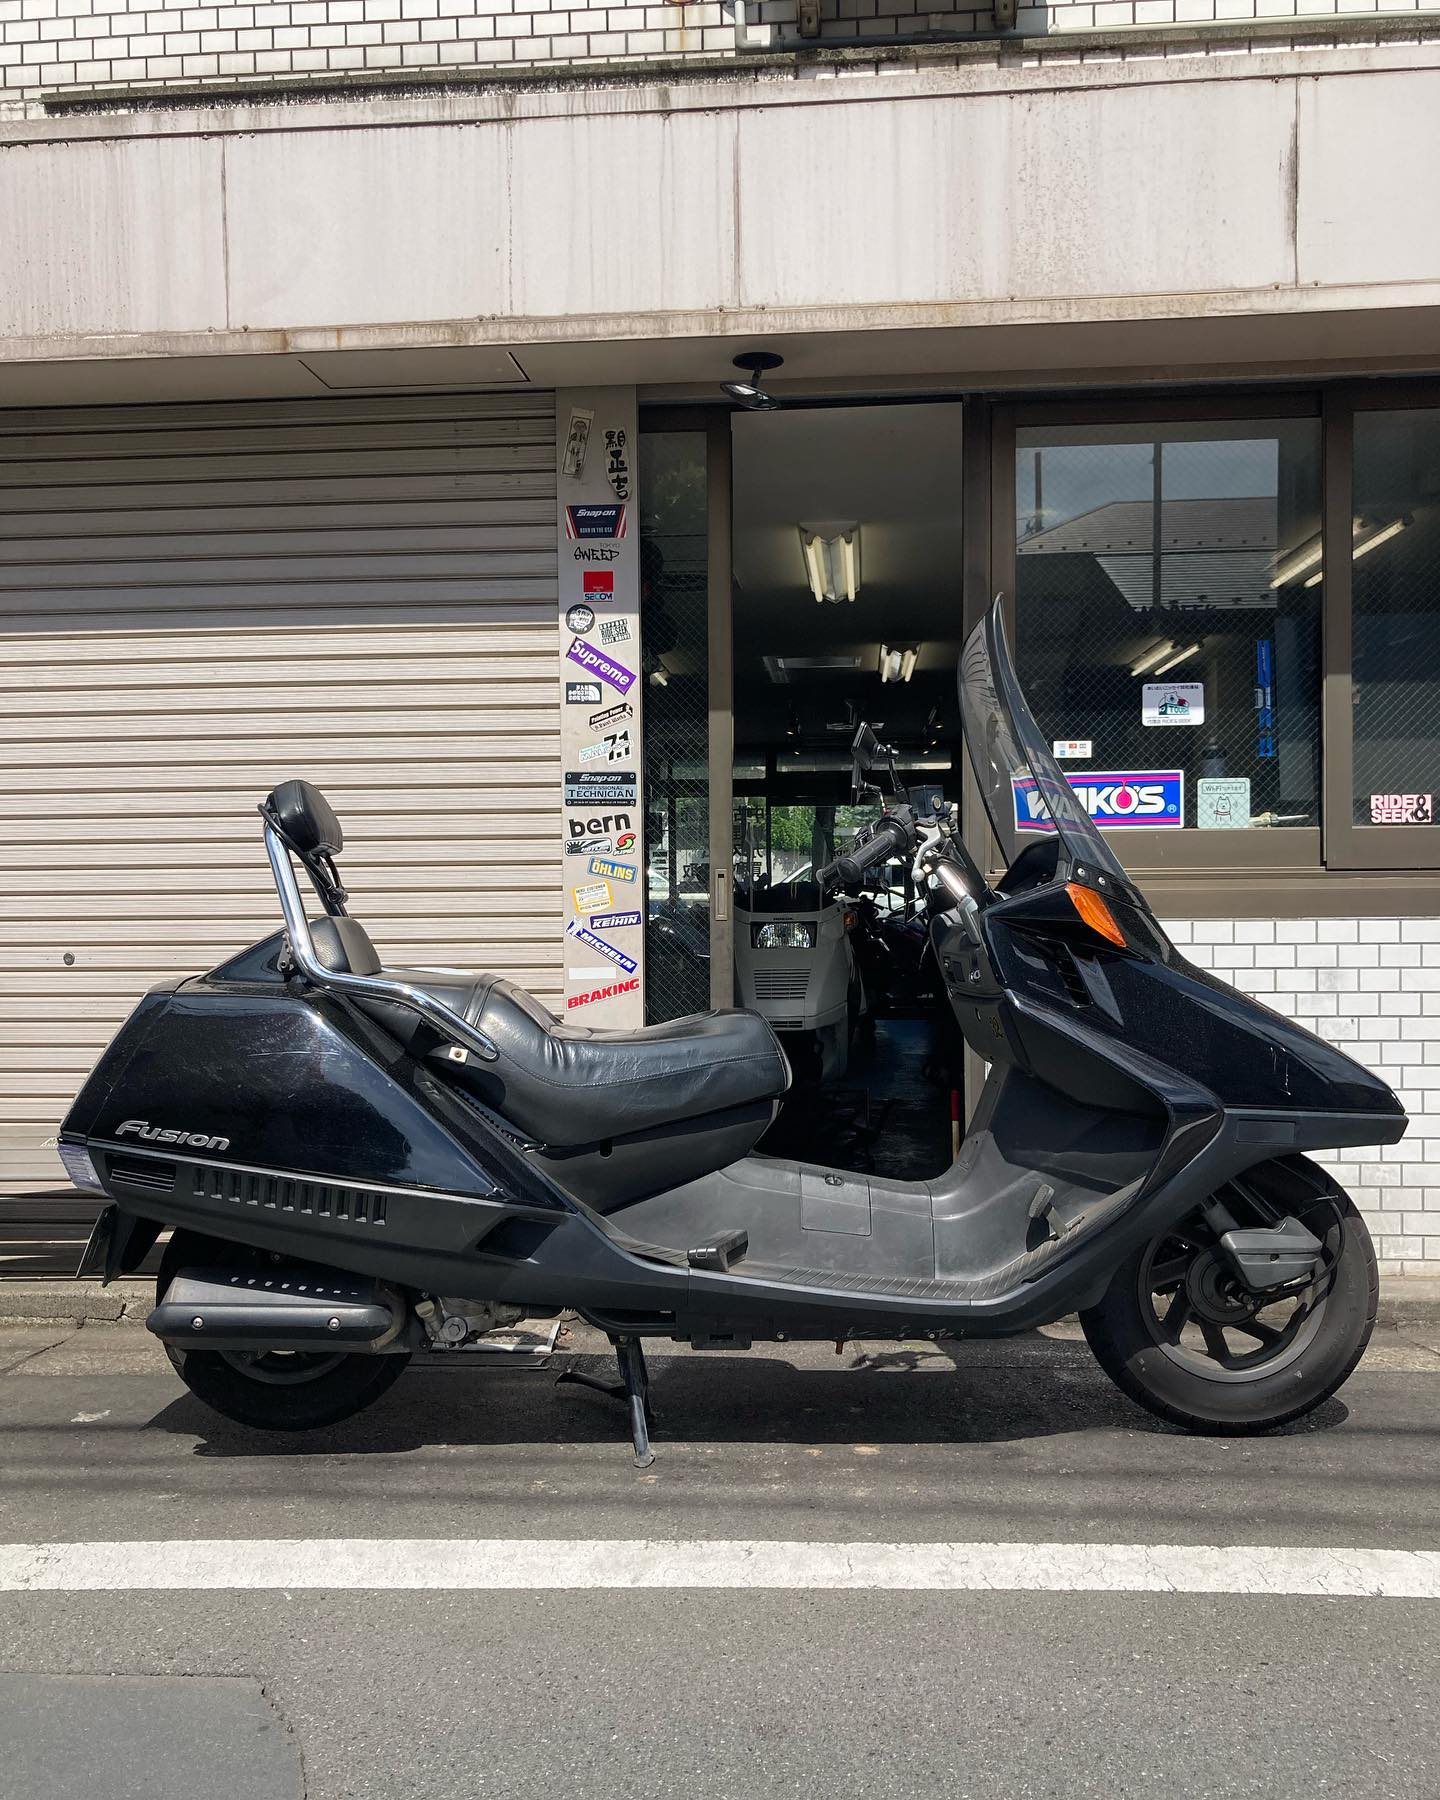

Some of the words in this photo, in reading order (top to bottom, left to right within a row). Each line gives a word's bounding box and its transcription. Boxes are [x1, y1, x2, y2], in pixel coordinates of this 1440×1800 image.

[576, 509, 616, 517] Snap-on
[574, 547, 620, 561] SWEEP
[571, 640, 629, 685] Supreme
[579, 774, 622, 783] Snap-on
[568, 790, 634, 798] TECHNICIAN
[1027, 785, 1166, 819] WAKO'S
[1370, 794, 1414, 809] RIDE
[568, 814, 632, 838] bern
[1370, 809, 1414, 823] SEEK
[592, 860, 633, 880] ÖHLINS
[580, 932, 635, 969] MICHELIN
[568, 978, 640, 1009] BRAKING
[115, 1120, 230, 1151] Fusion
